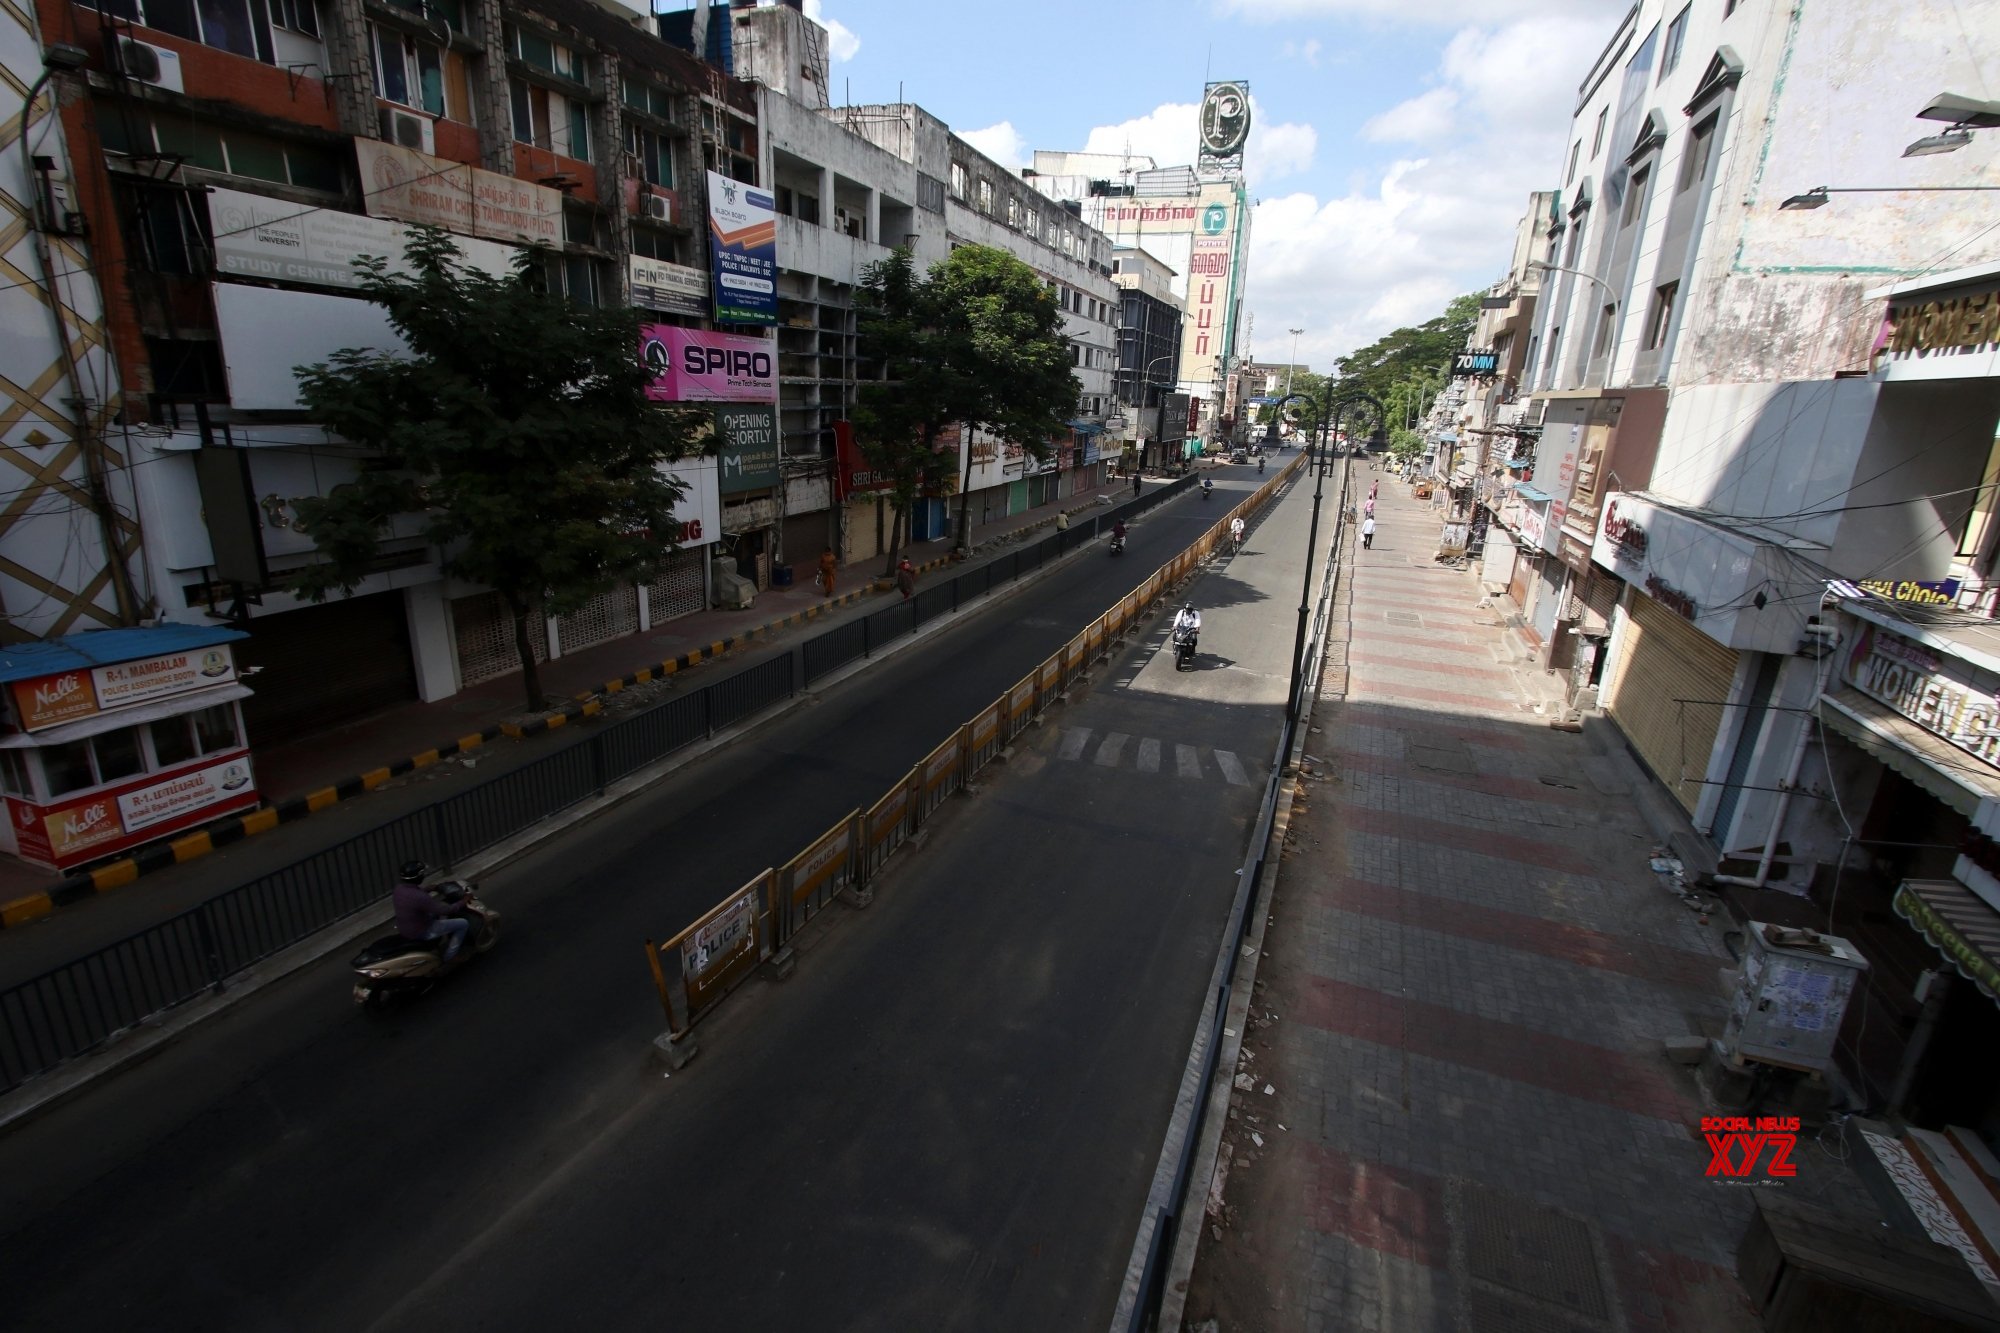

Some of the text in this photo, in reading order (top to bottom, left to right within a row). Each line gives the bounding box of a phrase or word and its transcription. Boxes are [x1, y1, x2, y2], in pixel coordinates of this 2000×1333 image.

[409, 188, 452, 212] SHRIRAM
[455, 199, 480, 219] CHITS
[482, 206, 528, 230] TAMILNADU
[258, 227, 270, 236] THE
[271, 229, 300, 240] PEOPLE'S
[258, 235, 300, 248] UNIVERSITY
[718, 251, 731, 260] UPSC
[750, 257, 760, 266] NEET
[225, 255, 348, 283] STUDY CENTRE
[634, 268, 657, 284] IFIN
[722, 261, 738, 271] POLICE
[741, 264, 760, 275] RAILWAYS
[684, 277, 700, 288] SERVICES
[684, 345, 771, 378] SPIRO
[1456, 355, 1494, 369] 70MM
[728, 379, 742, 387] Prime
[753, 380, 772, 388] Services
[724, 413, 770, 429] OPENING
[853, 472, 871, 486] SHRI
[106, 657, 187, 683] R-1. MAMBALAM
[102, 683, 129, 697] POLICE
[131, 676, 172, 690] ASSISTANCE
[174, 670, 196, 681] BOOTH
[35, 675, 80, 712] Nalli
[1865, 654, 1962, 736] WOMEN
[32, 702, 93, 721] SILK SAREES
[132, 793, 153, 806] R-1.
[64, 801, 107, 844] Nalli
[83, 828, 119, 843] SAREES
[807, 846, 837, 875] POLICE
